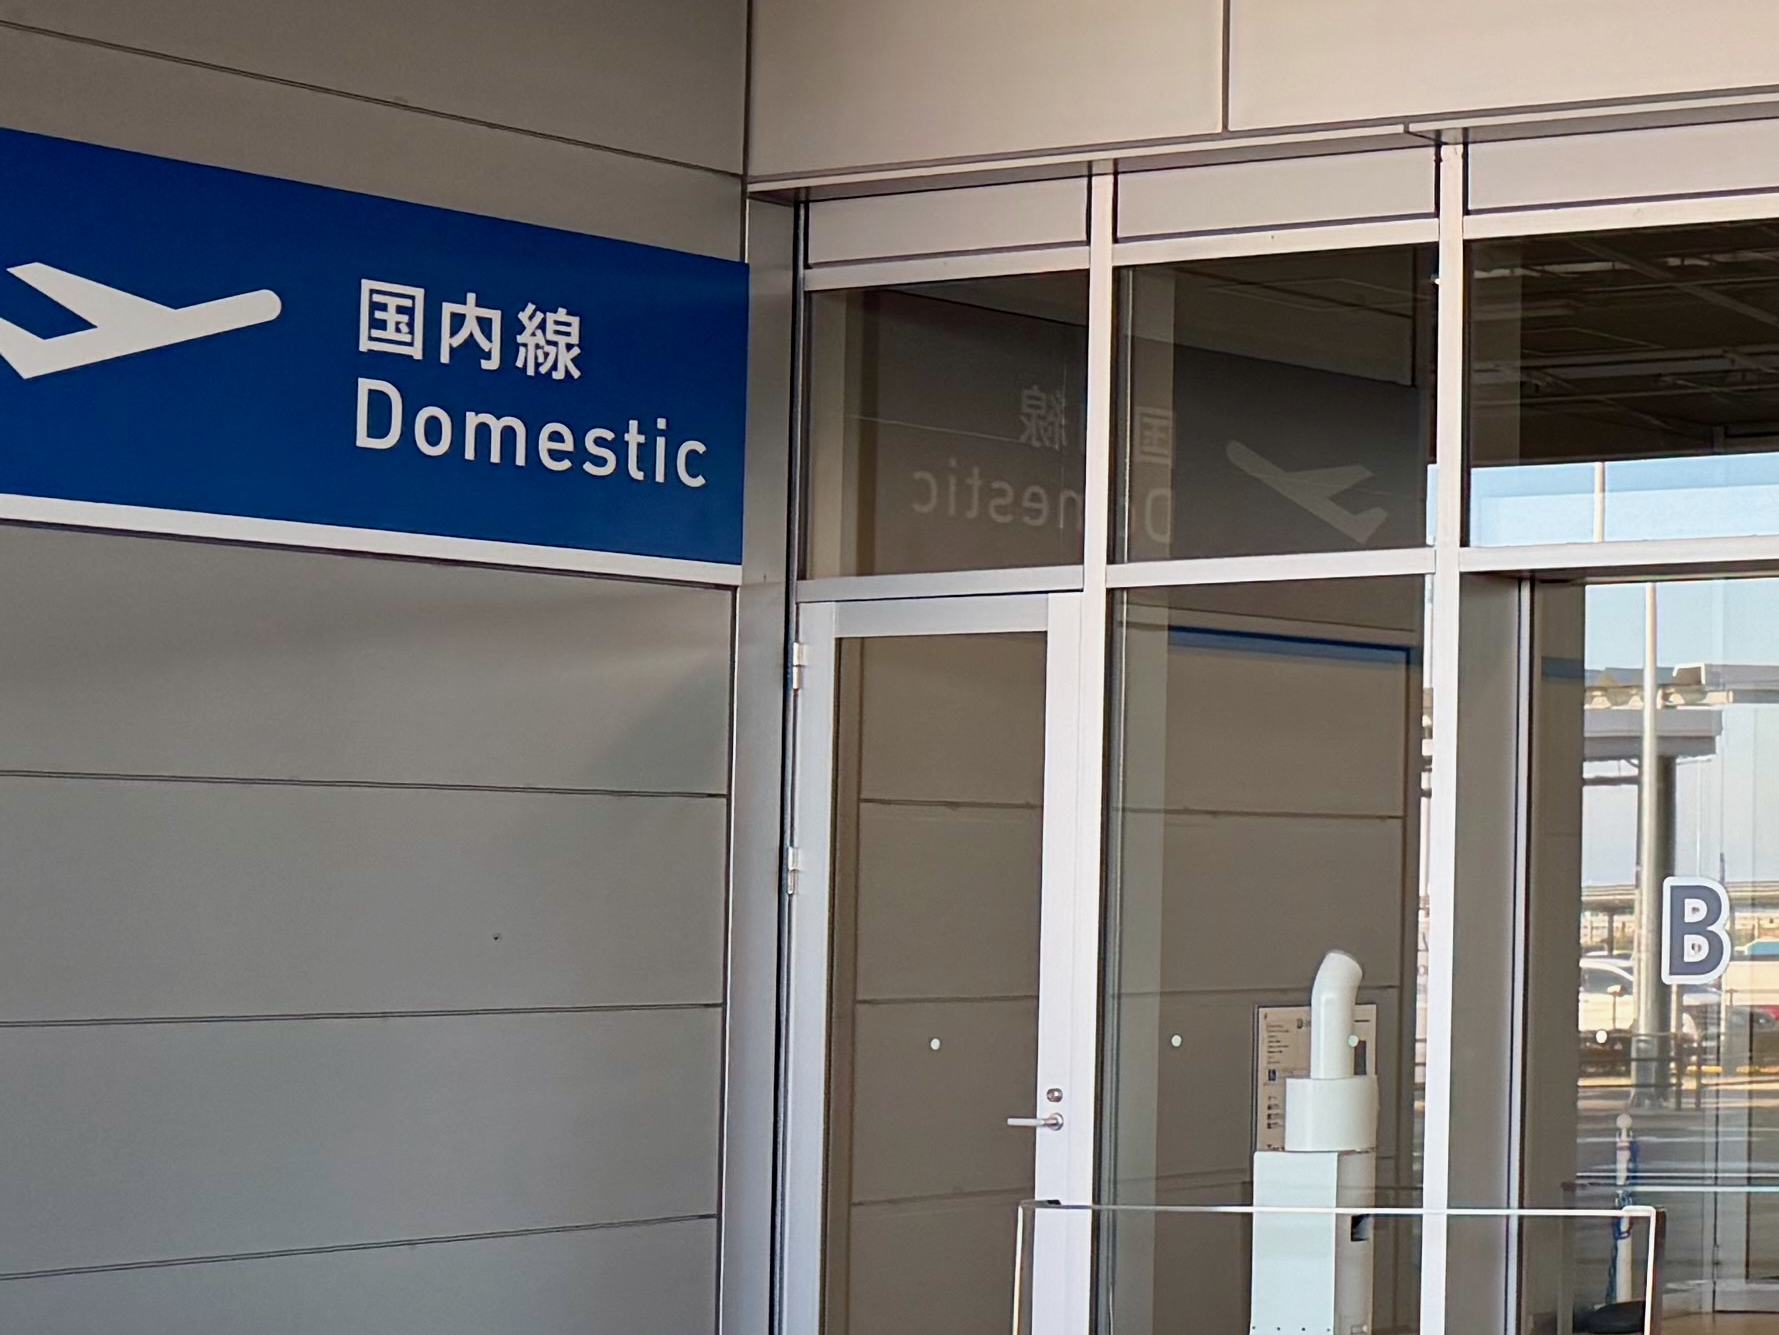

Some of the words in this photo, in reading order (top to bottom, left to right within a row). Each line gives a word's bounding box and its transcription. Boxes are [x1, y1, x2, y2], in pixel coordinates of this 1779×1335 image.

[358, 278, 582, 380] 国内線
[355, 377, 707, 488] Domestic
[1663, 879, 1730, 981] B
